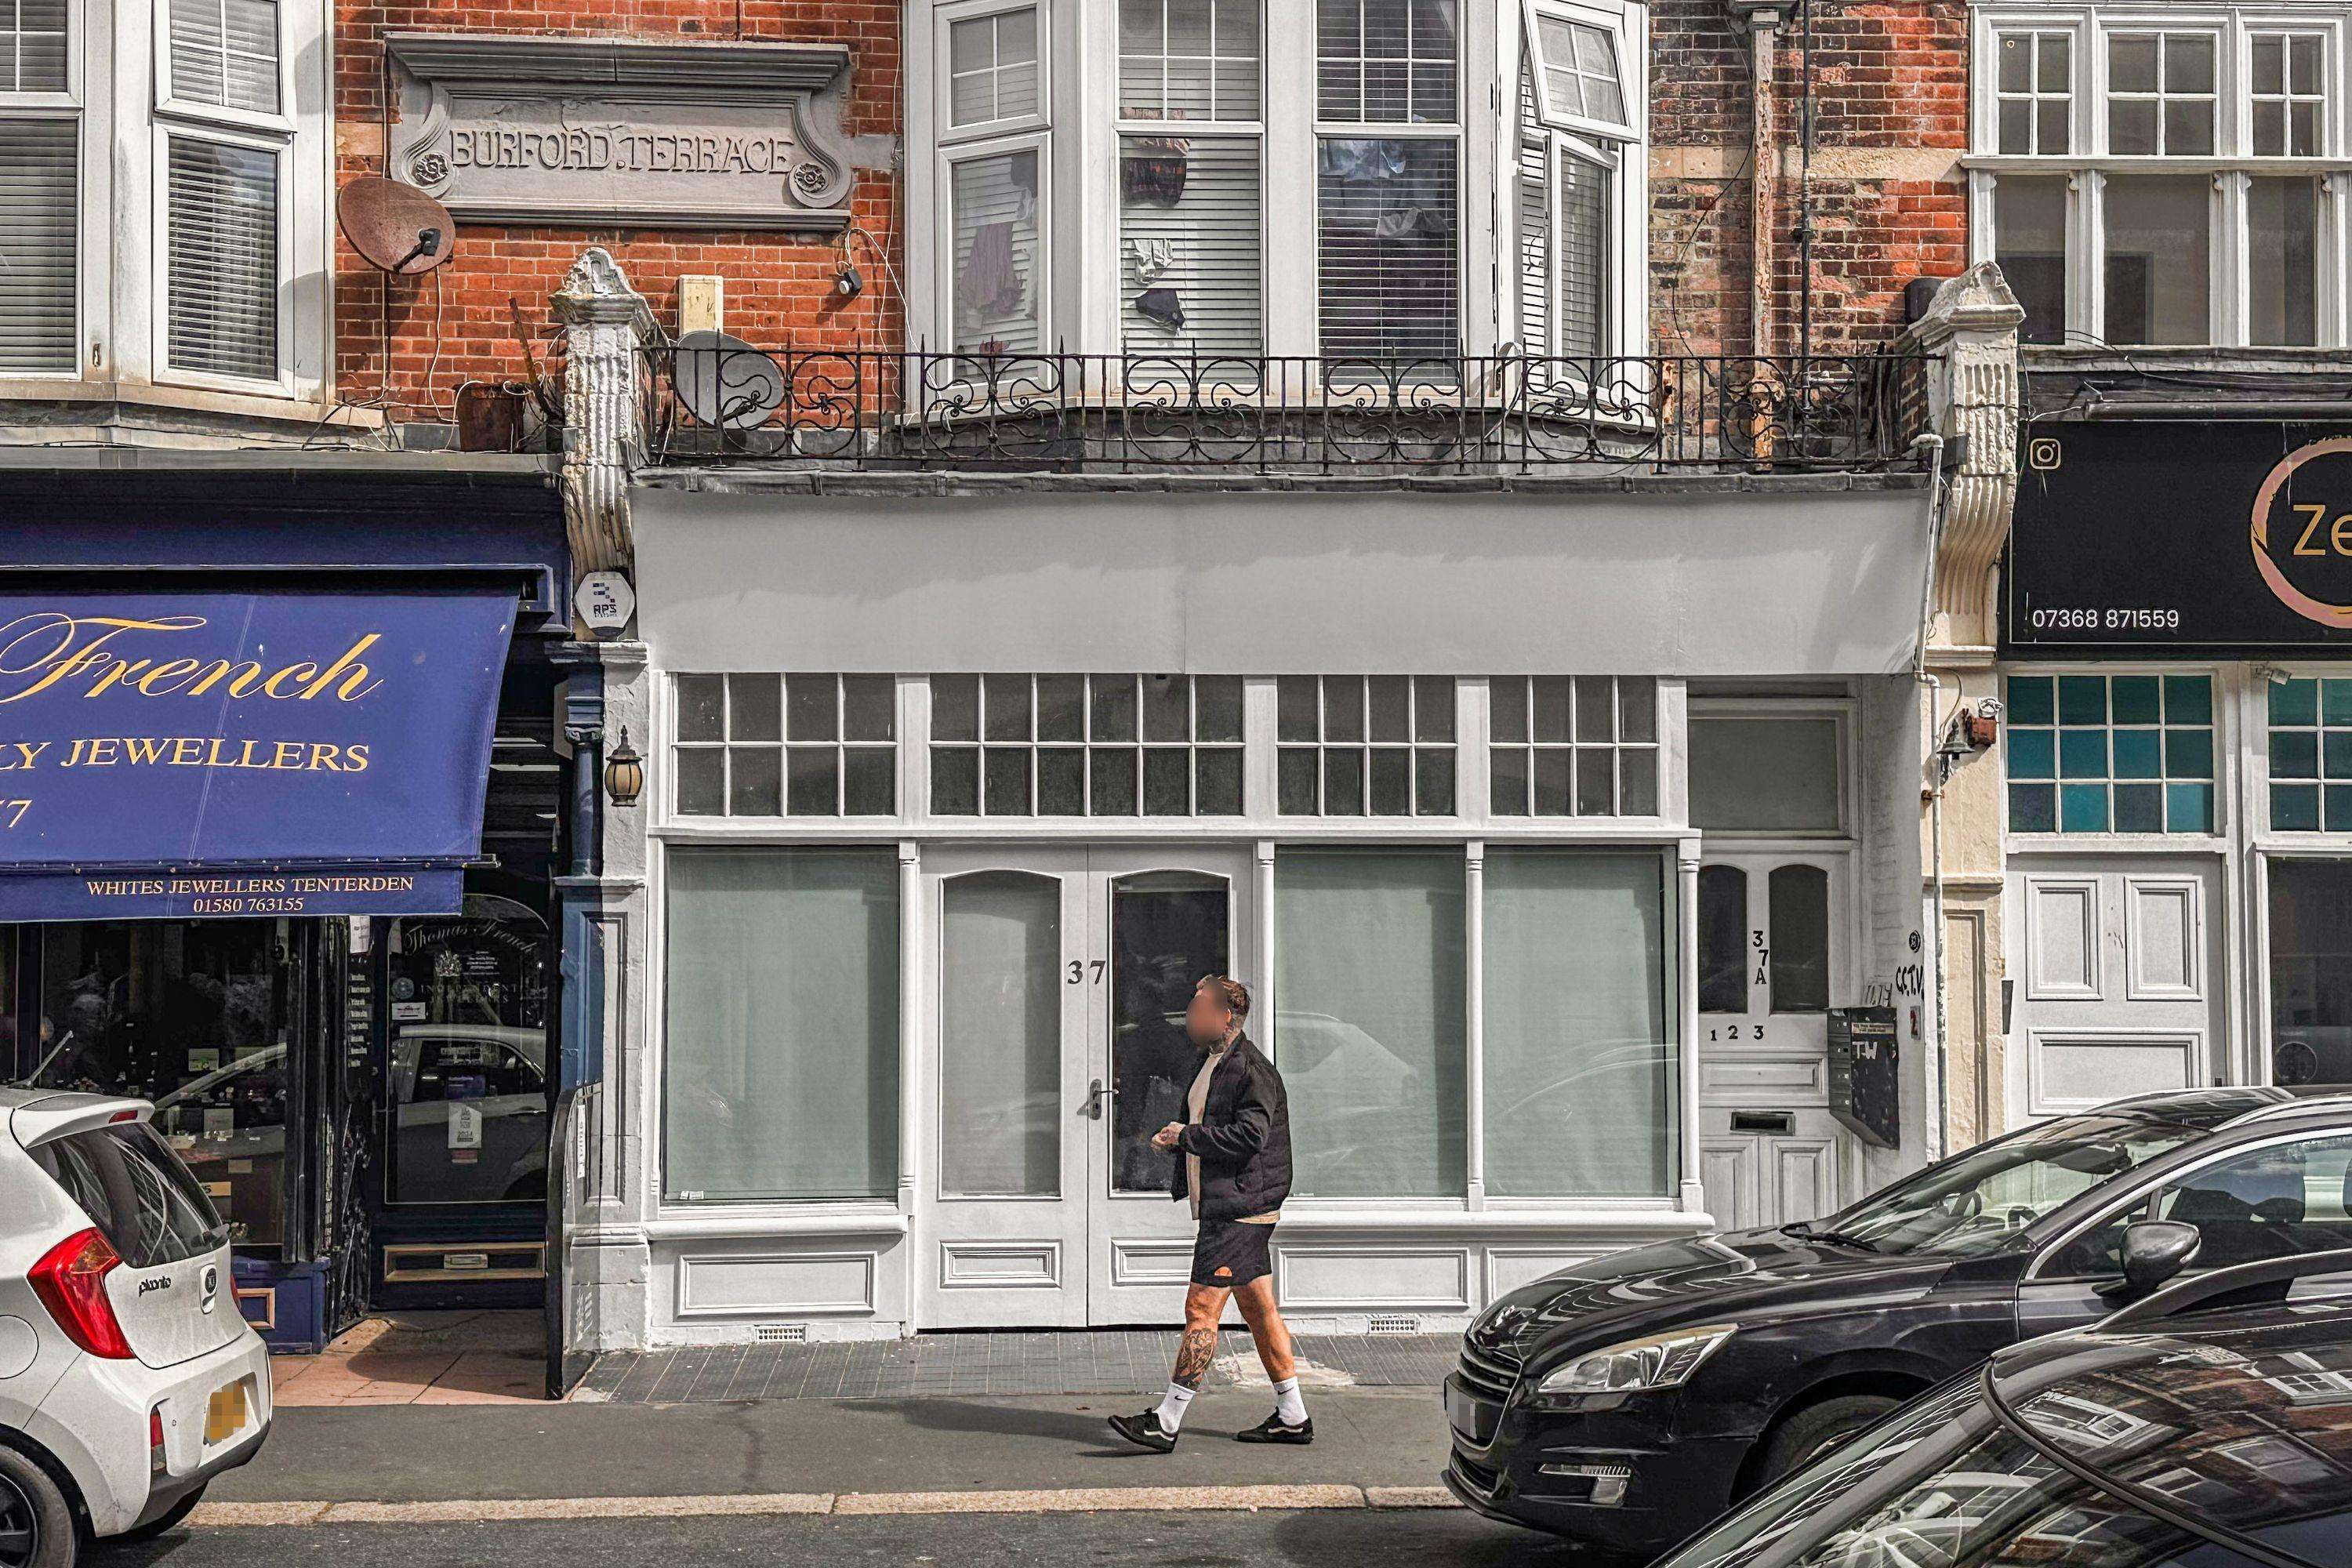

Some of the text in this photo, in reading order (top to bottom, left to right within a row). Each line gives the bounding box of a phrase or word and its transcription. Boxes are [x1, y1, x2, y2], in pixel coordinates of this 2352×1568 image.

[618, 134, 795, 175] TERRACE
[2032, 608, 2180, 629] 07368 871559
[0, 612, 384, 703] French
[60, 738, 369, 772] JEWELLERS
[87, 877, 414, 895] WHITES JEWELLERS TENTERDEN
[193, 897, 305, 913] 01580 763155
[1067, 960, 1106, 985] 37
[1728, 1025, 1738, 1040] 2
[1753, 1025, 1764, 1040] 3
